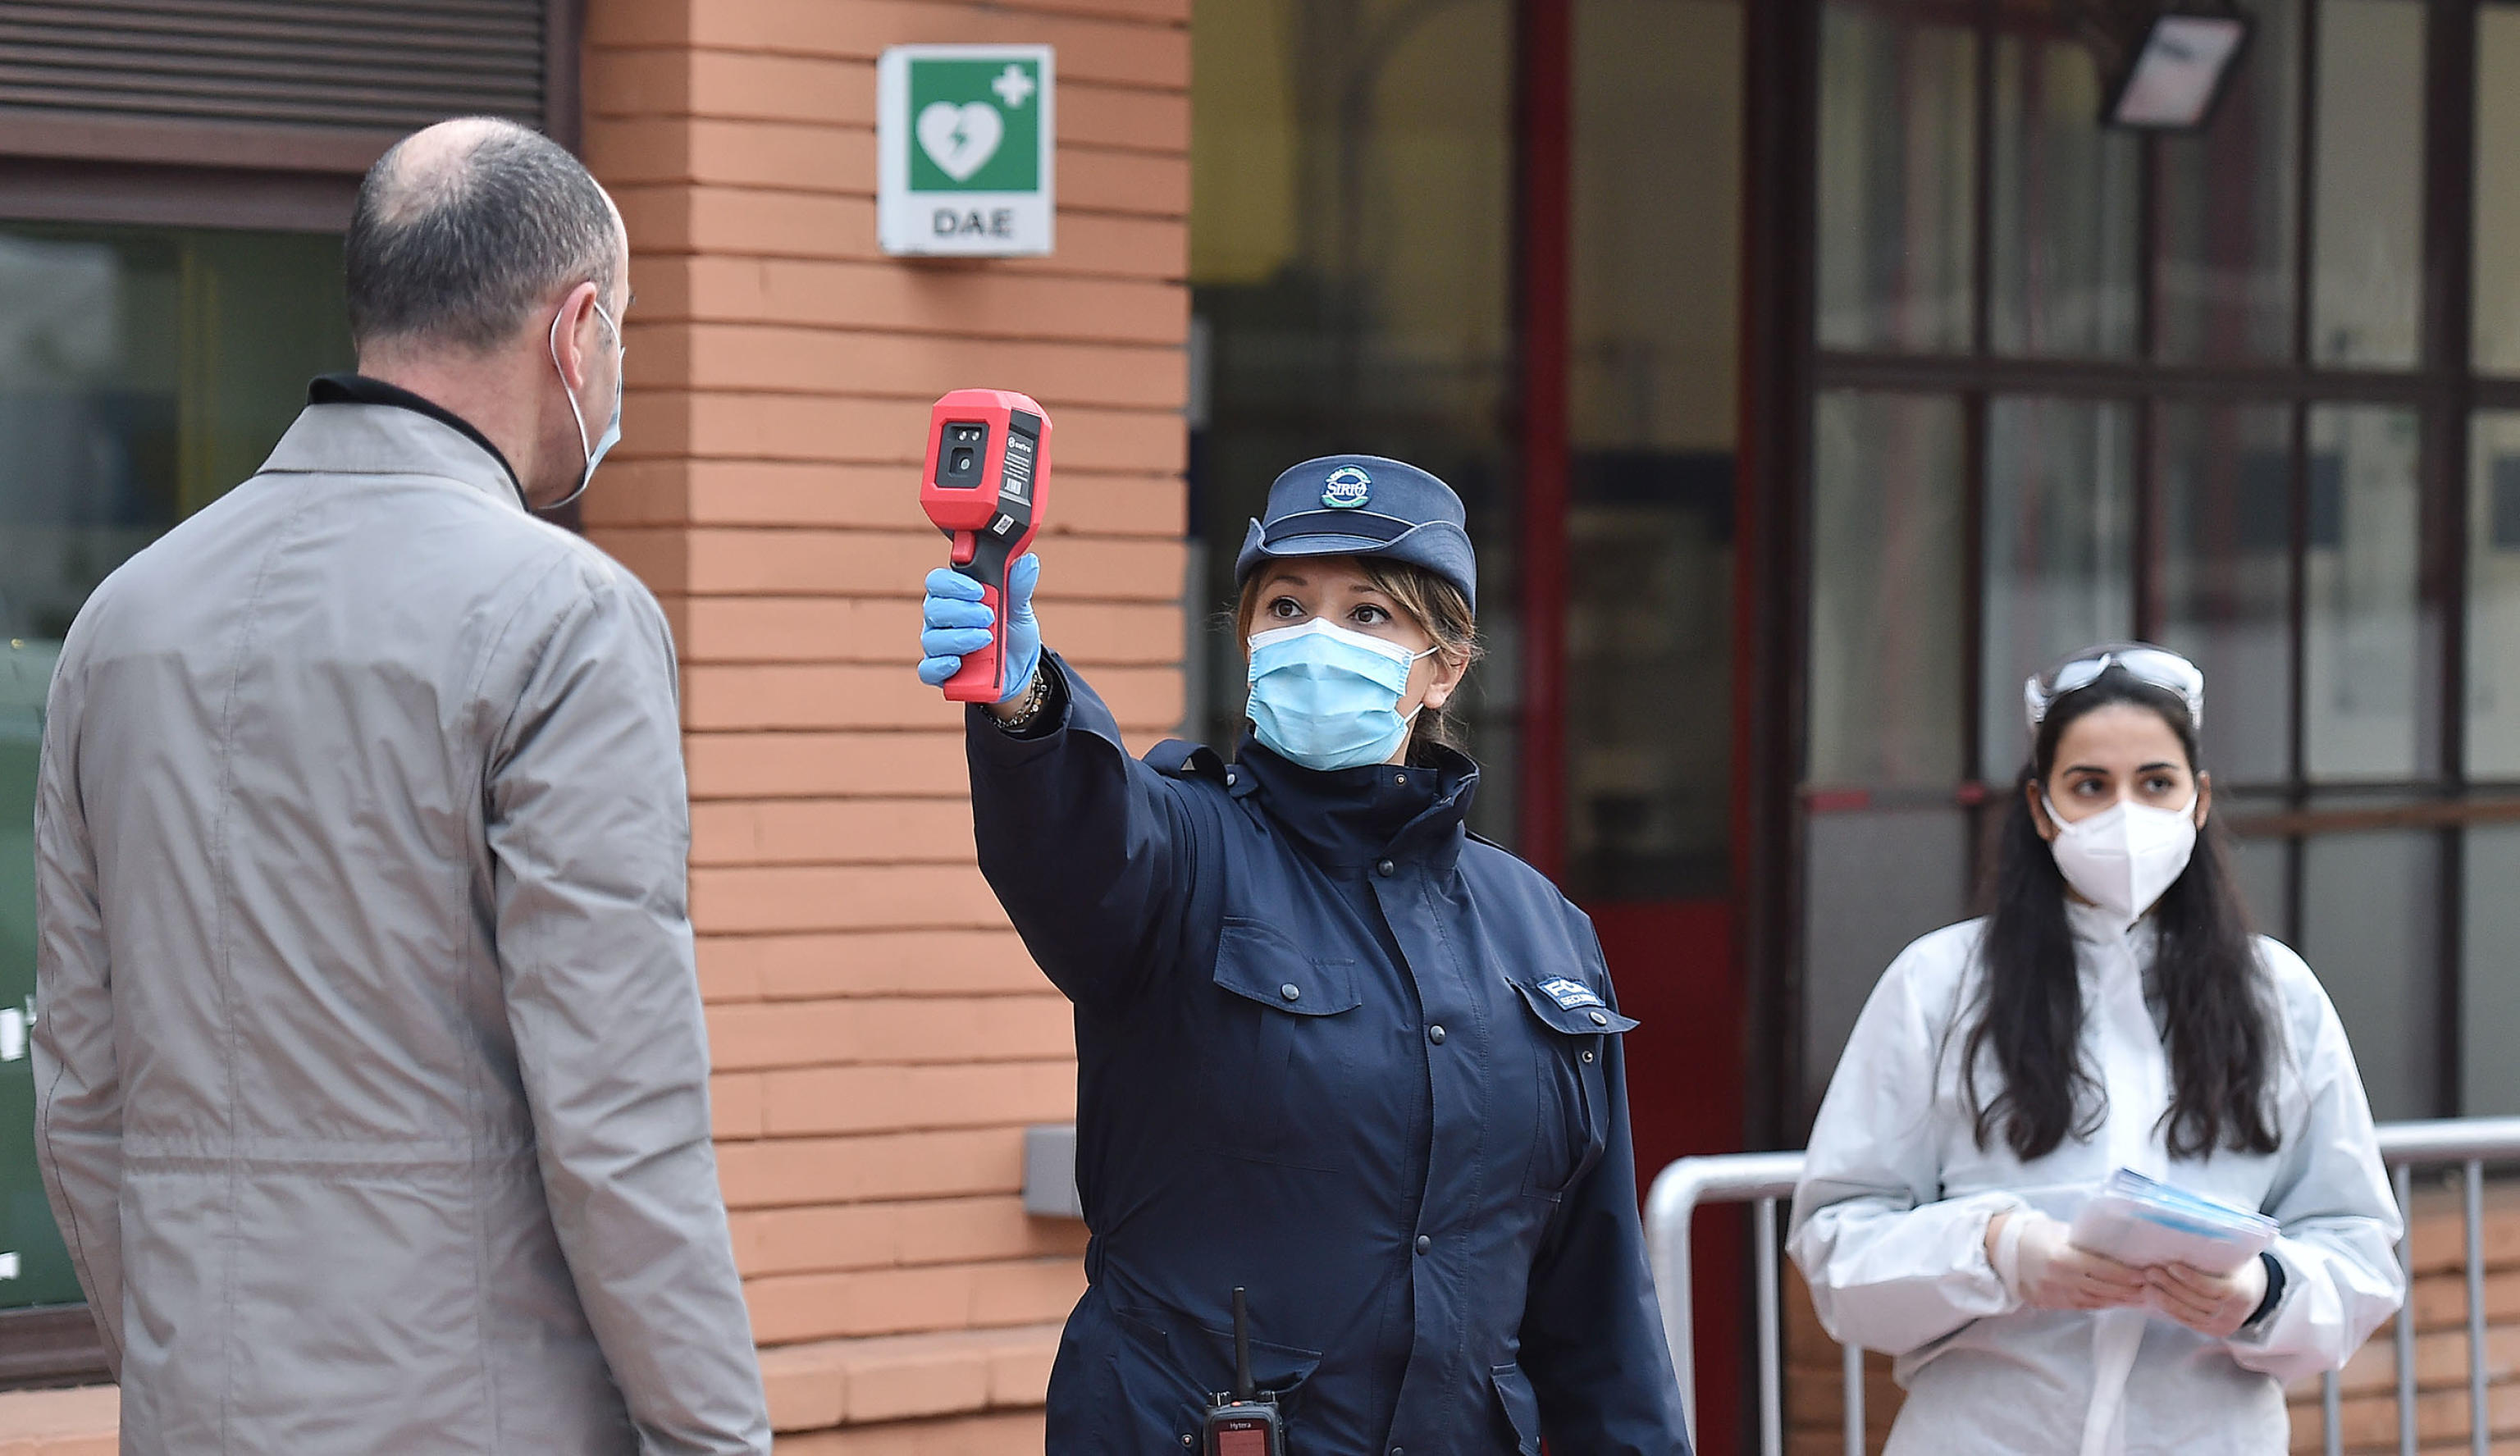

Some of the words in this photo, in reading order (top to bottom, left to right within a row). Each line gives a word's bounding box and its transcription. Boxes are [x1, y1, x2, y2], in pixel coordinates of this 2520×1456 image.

[933, 208, 1014, 238] DAE
[1326, 482, 1367, 496] SIRIO
[1230, 1422, 1252, 1431] Hytera
